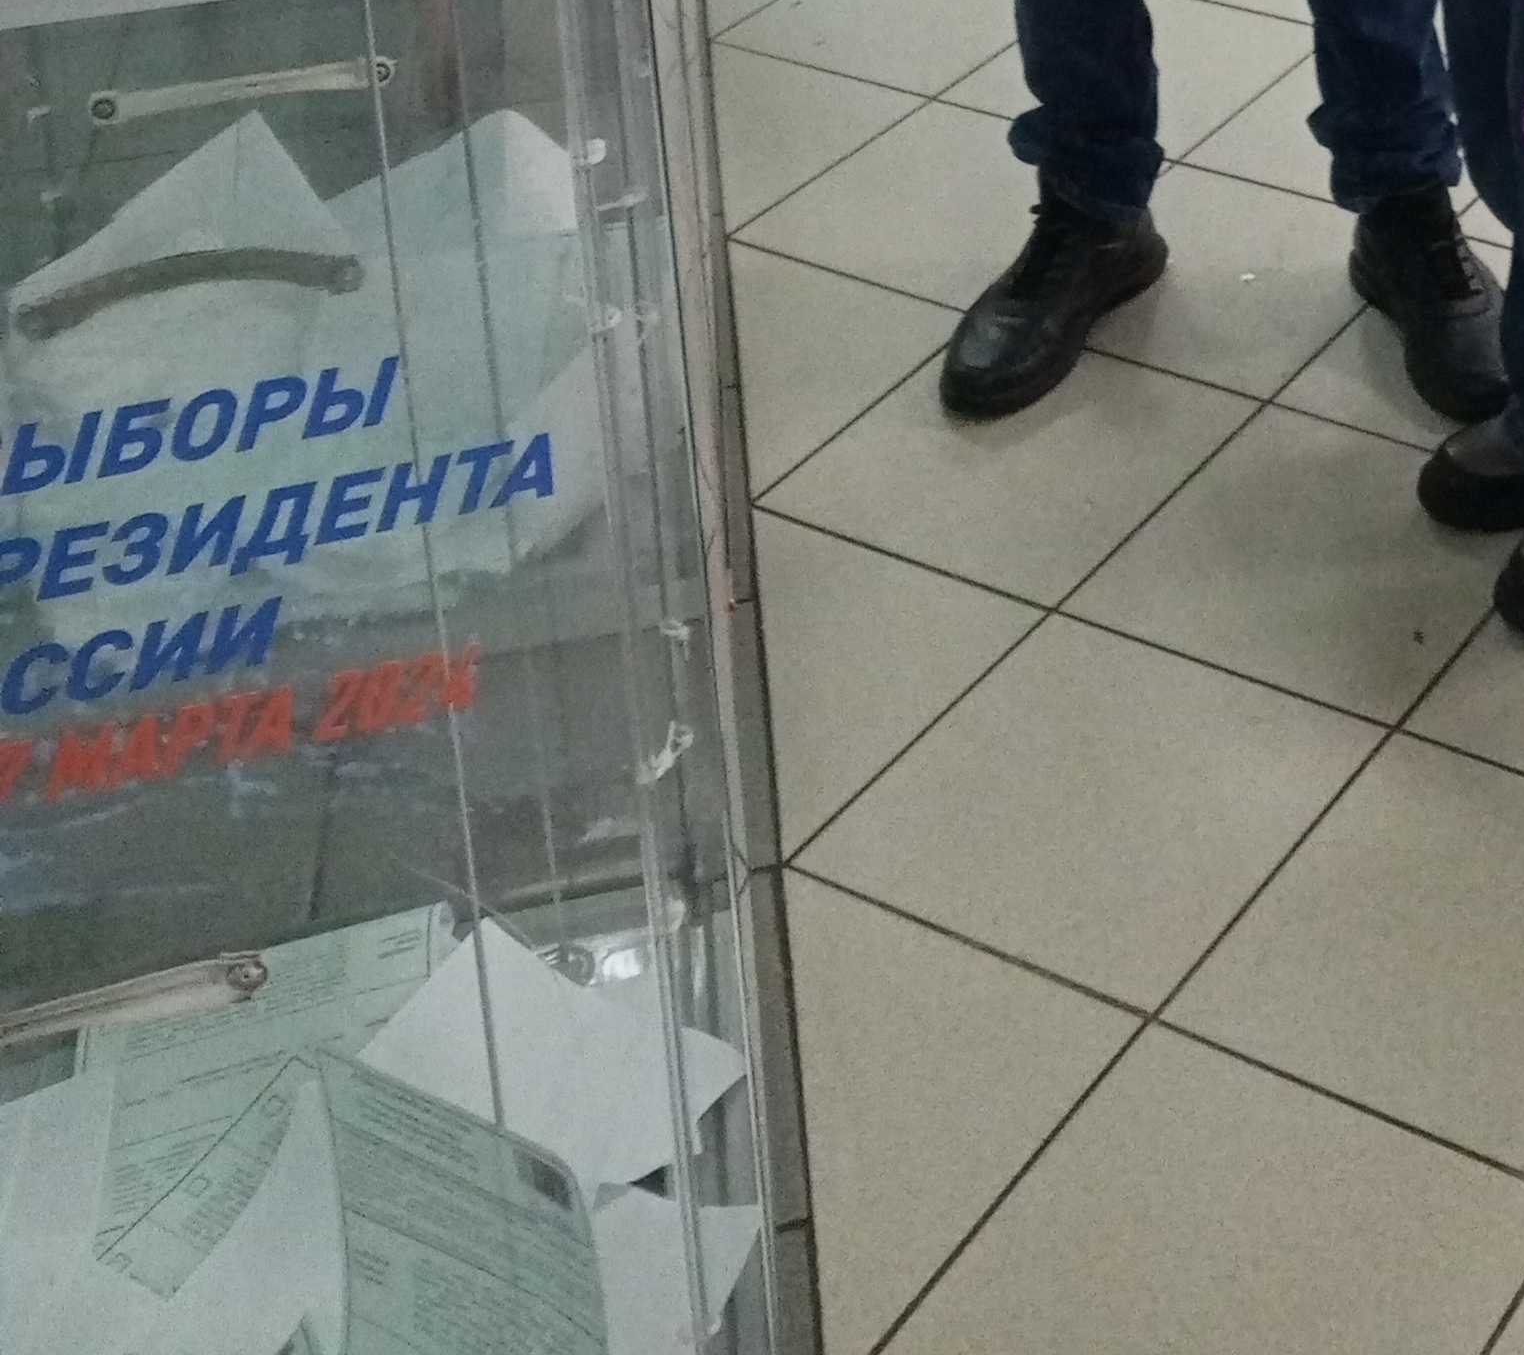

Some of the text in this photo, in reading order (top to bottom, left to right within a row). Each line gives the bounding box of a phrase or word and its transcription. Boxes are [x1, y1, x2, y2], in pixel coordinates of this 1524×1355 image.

[1, 356, 399, 496] ЫБОРЫ
[0, 432, 555, 602] РЕЗИДЕНТА
[0, 595, 283, 715] ССИИ
[44, 682, 293, 806] МАРТА
